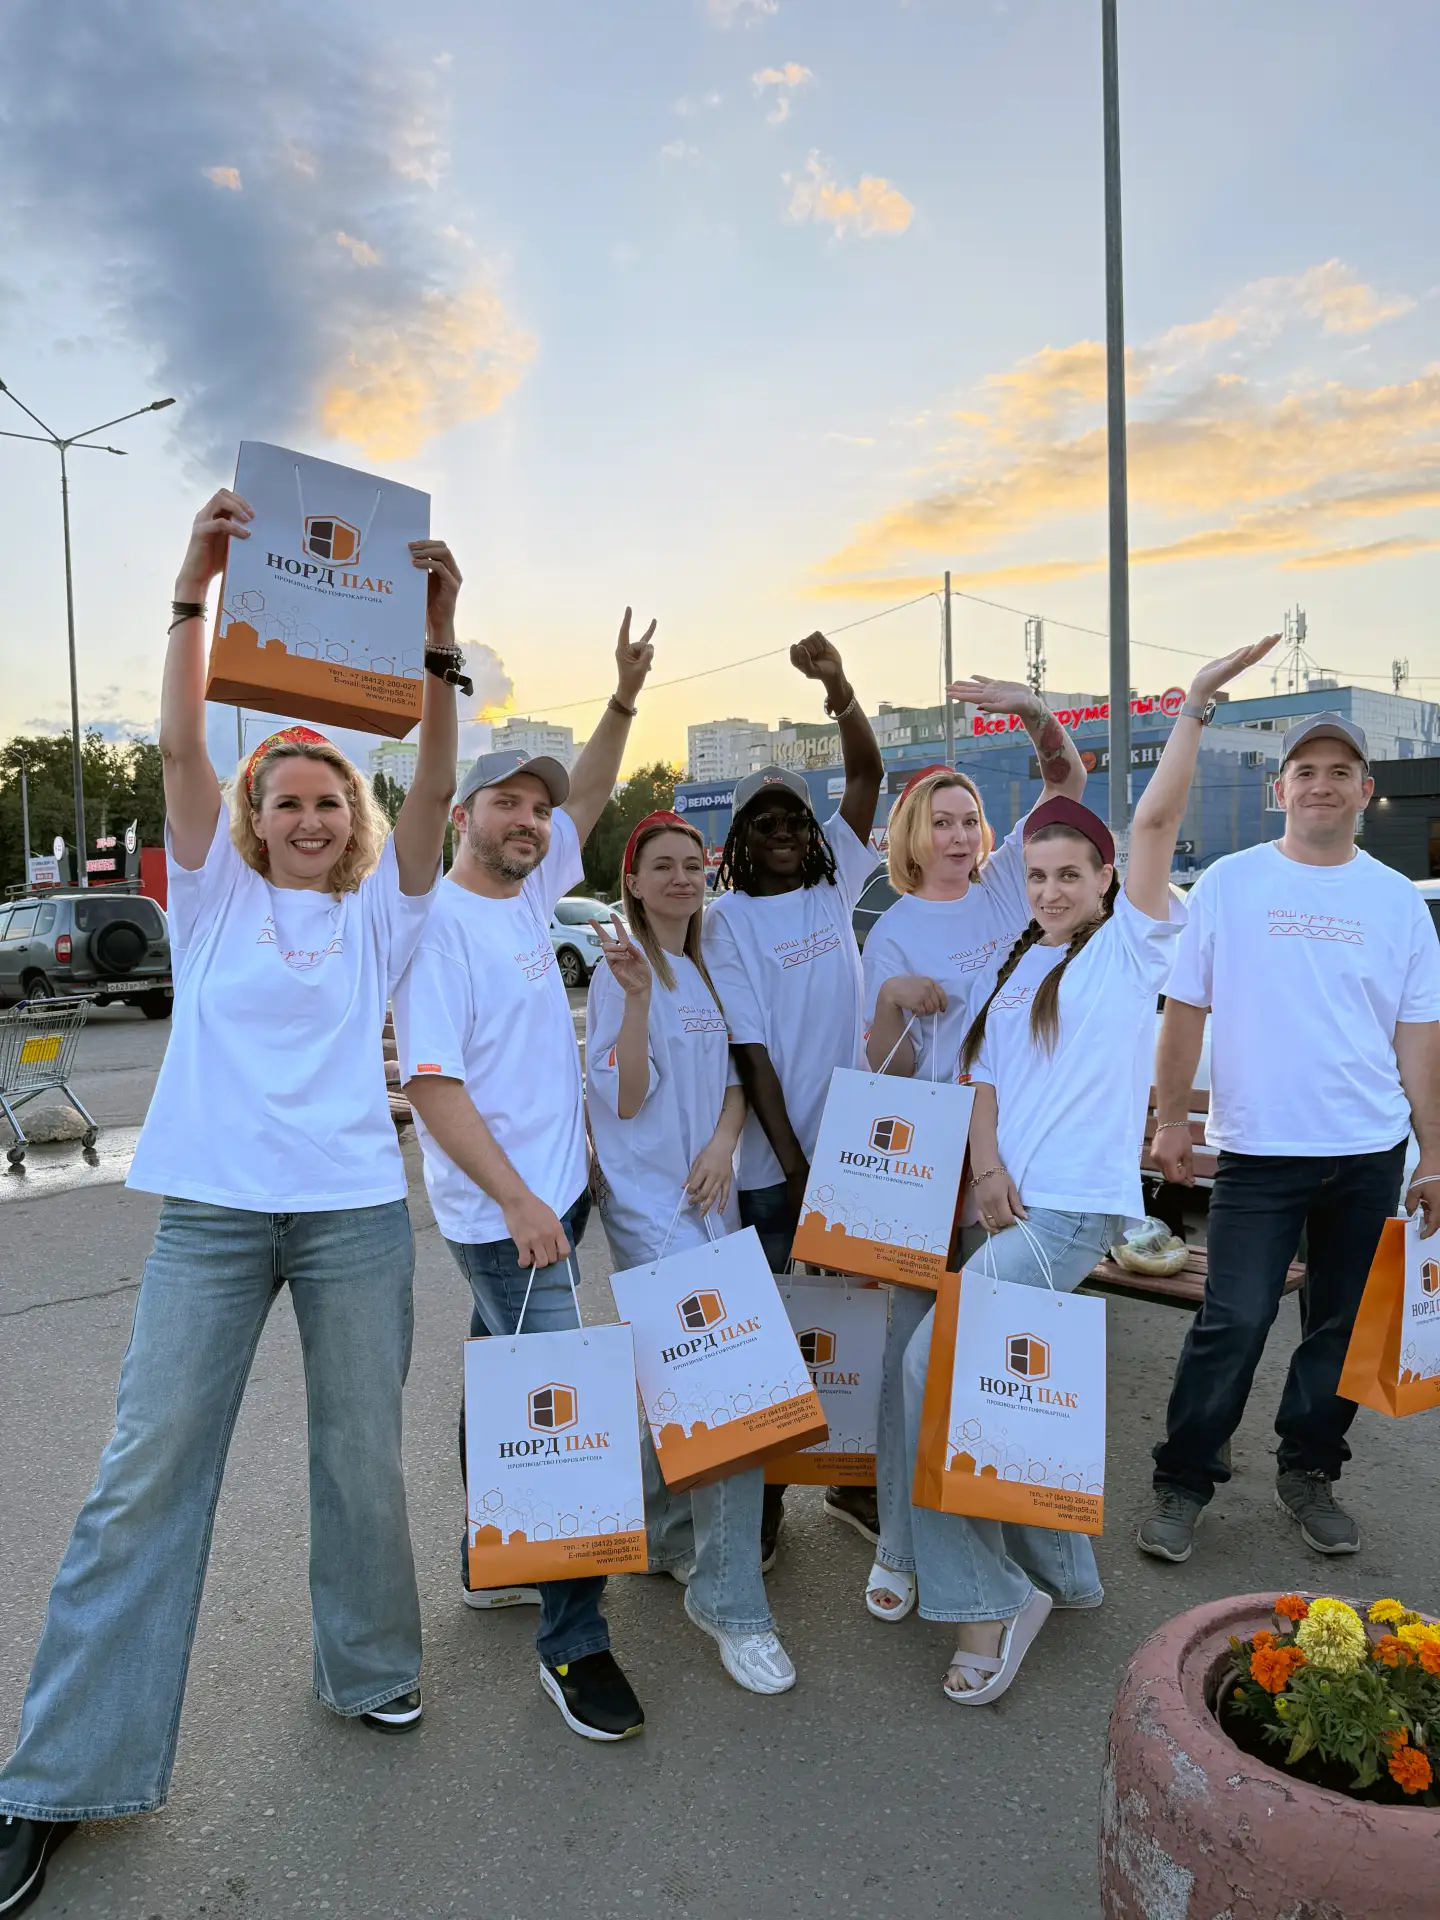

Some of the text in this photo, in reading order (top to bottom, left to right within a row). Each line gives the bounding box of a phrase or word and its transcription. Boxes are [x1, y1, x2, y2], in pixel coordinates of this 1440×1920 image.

[266, 551, 393, 594] НОРД ПАК
[773, 735, 844, 761] КЛОНДА
[688, 791, 733, 807] ВЕЛО-РАЙ
[839, 1151, 934, 1179] НОРД ПАК
[1412, 1300, 1435, 1316] НОРД
[660, 1316, 761, 1363] НОРД ПАК
[822, 1372, 859, 1385] ПАК
[979, 1376, 1078, 1408] НОРД ПАК
[498, 1432, 610, 1458] НОРД ПАК
